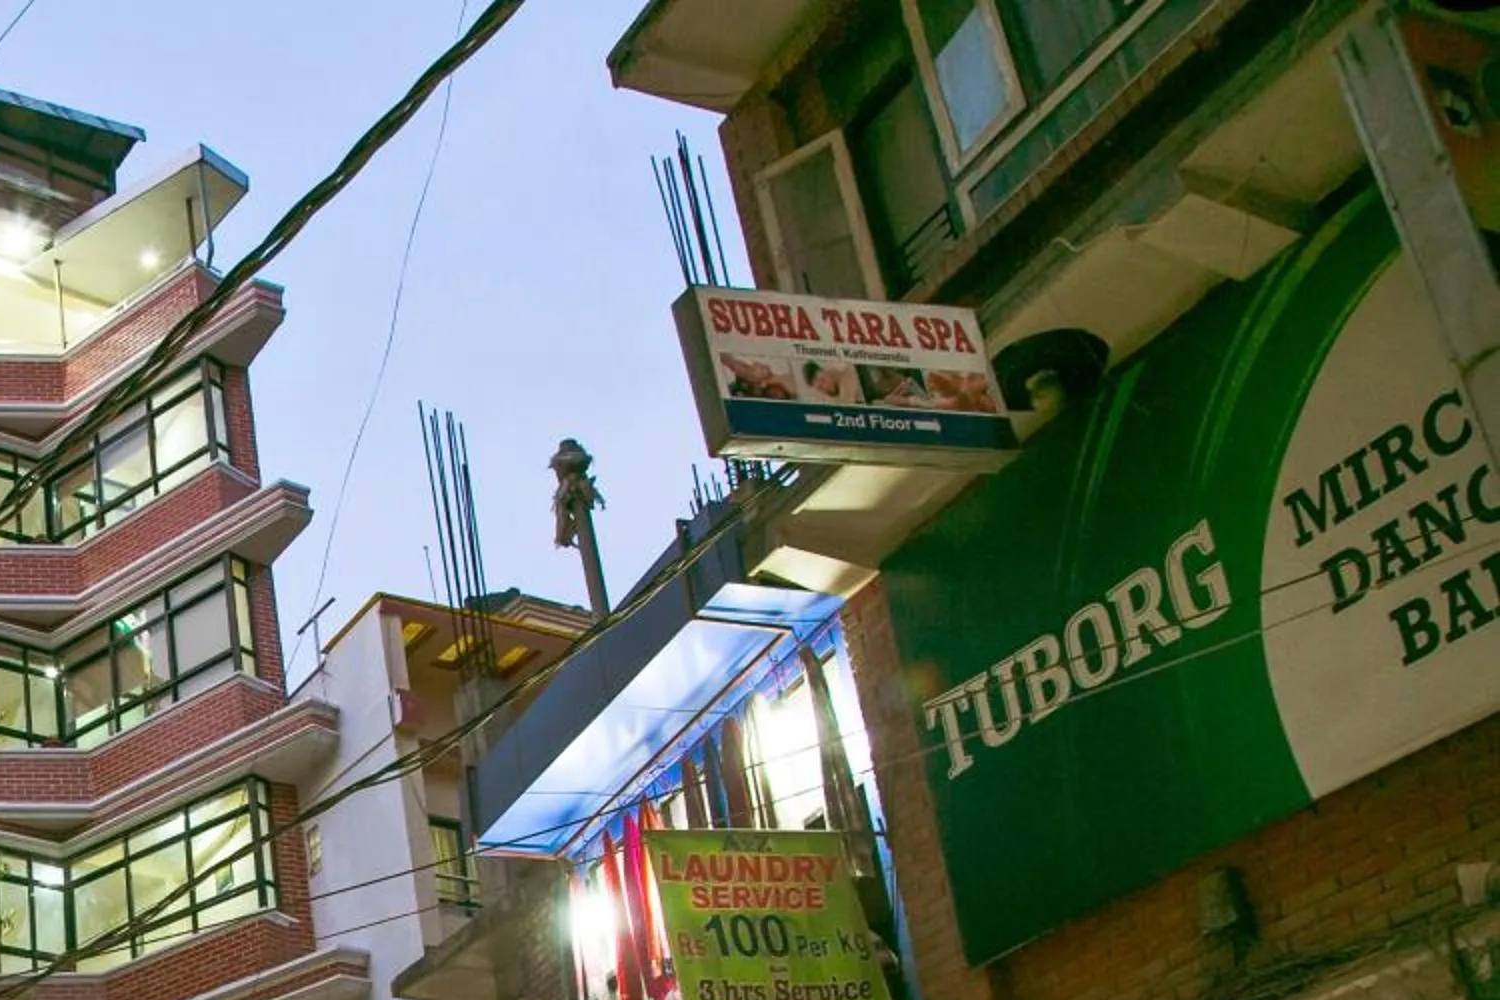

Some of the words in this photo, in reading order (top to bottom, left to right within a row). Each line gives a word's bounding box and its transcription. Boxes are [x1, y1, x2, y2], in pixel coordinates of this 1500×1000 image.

[707, 298, 820, 341] SUBHA
[821, 307, 913, 349] TARA
[912, 316, 977, 354] SPA
[833, 411, 866, 430] 2nd
[868, 413, 912, 431] Floor
[1284, 387, 1473, 548] MIRC
[922, 518, 1231, 780] TUBORG
[660, 854, 839, 882] LAUNDRY
[691, 885, 824, 909] SERVICE
[704, 914, 789, 957] 100
[794, 935, 829, 957] Per
